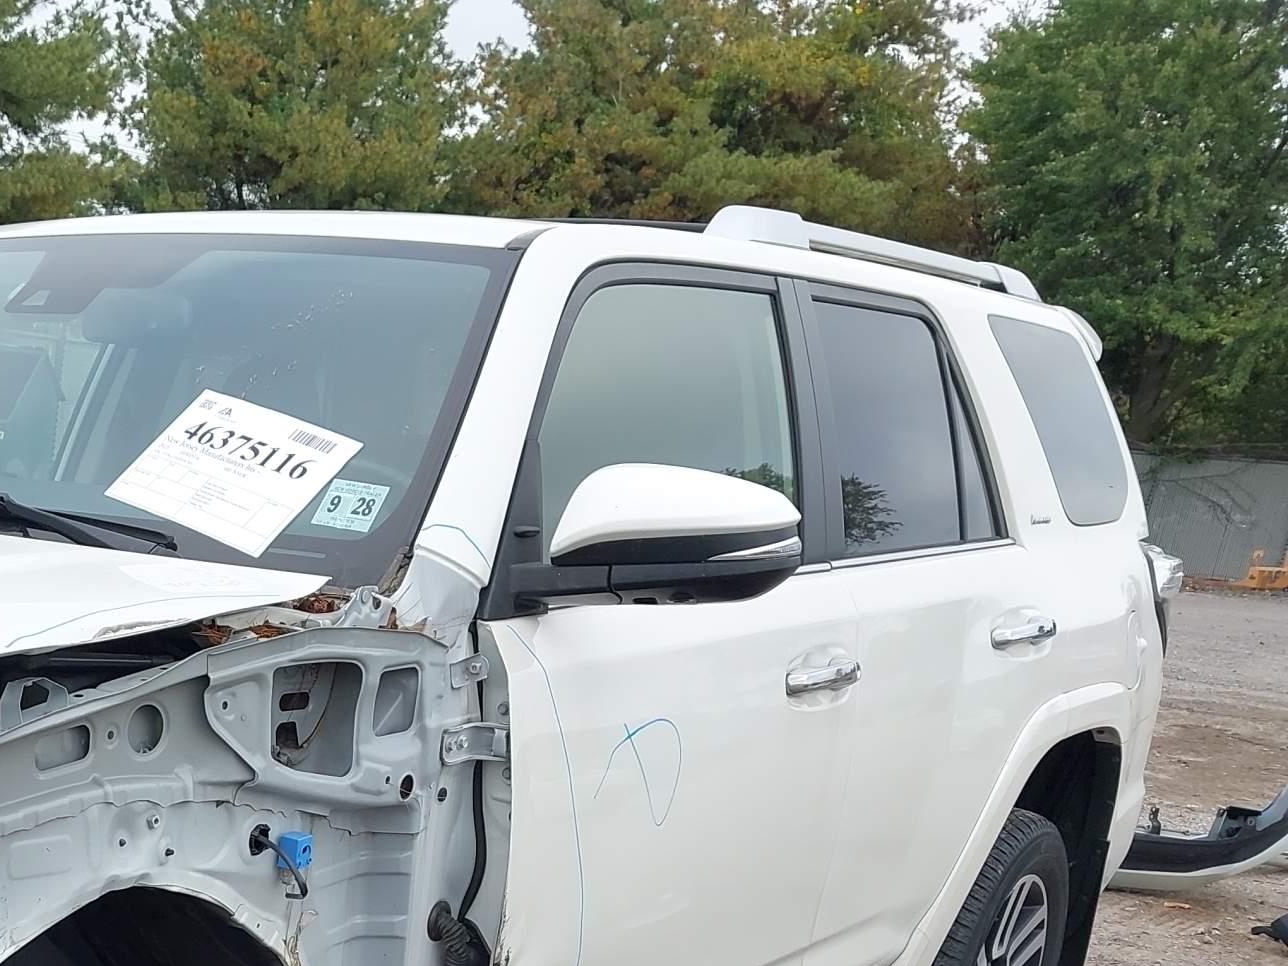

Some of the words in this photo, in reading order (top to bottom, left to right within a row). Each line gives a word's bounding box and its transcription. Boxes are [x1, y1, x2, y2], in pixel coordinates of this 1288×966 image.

[183, 420, 316, 480] 46375116
[326, 494, 342, 513] 9
[350, 497, 376, 517] 28
